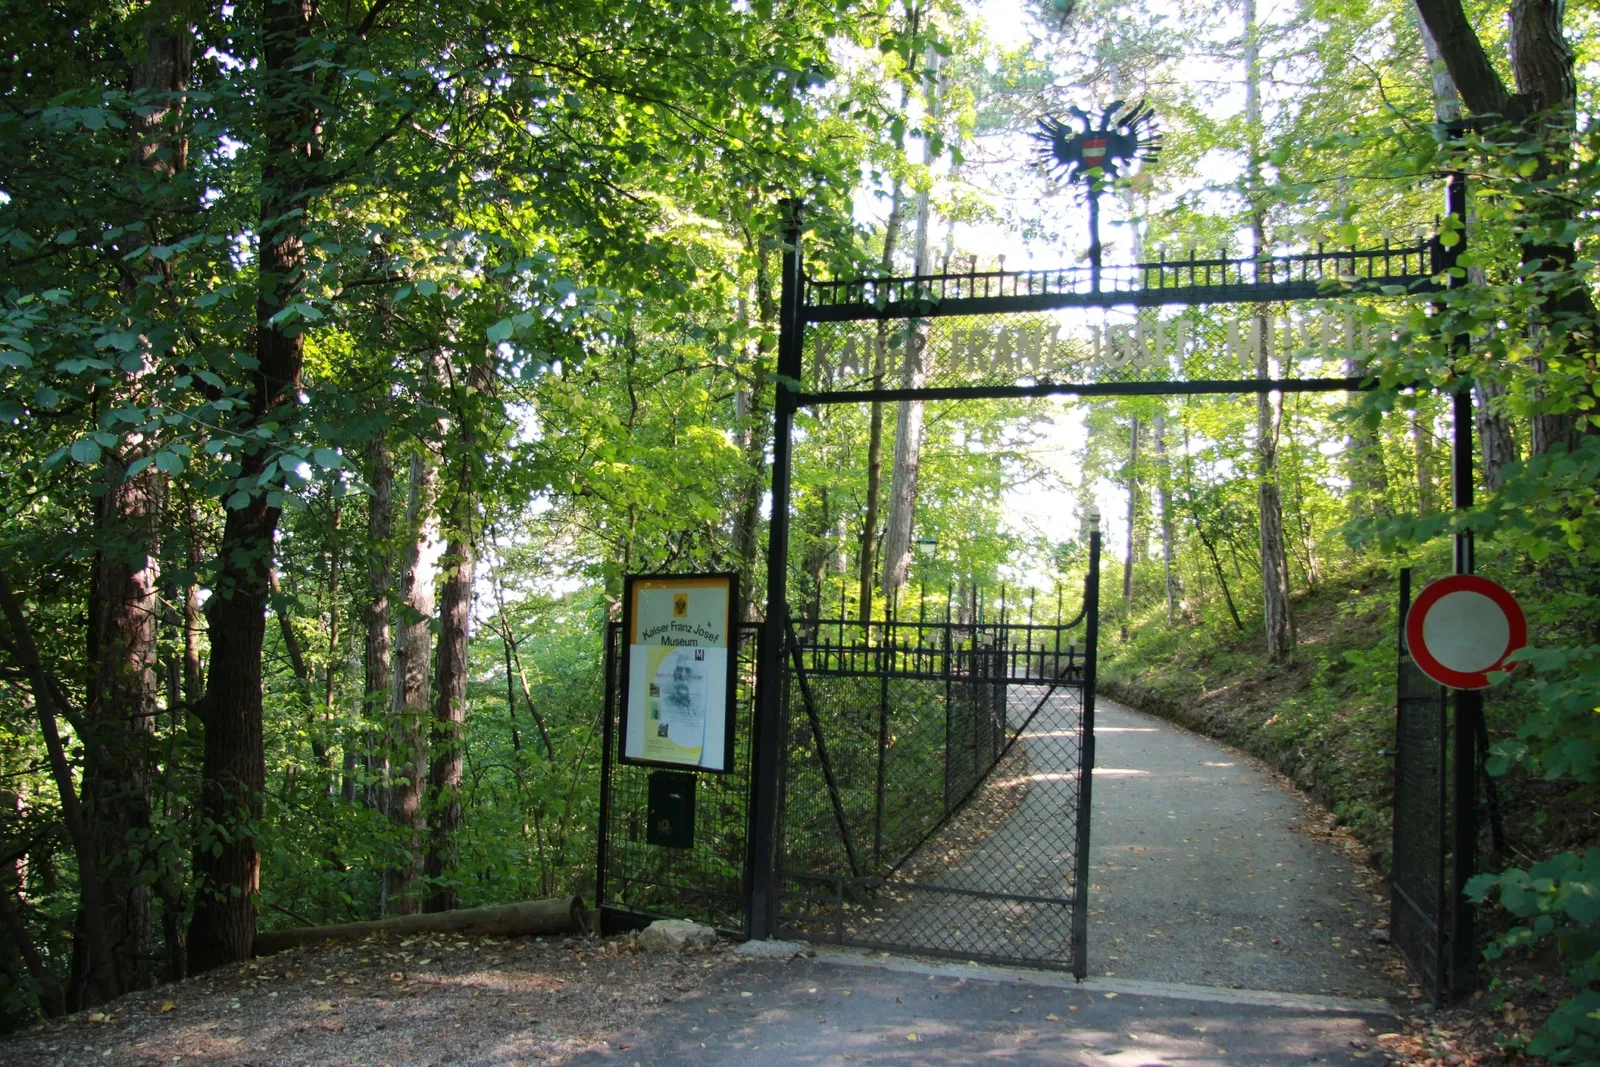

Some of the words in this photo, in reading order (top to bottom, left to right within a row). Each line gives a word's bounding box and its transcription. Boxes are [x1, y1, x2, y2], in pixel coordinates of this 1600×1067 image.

[814, 332, 927, 378] KAISER
[950, 325, 1062, 372] FRANZ
[1084, 320, 1194, 367] JOSEF
[642, 624, 669, 640] Kaiser
[670, 621, 692, 633] Franz
[693, 625, 719, 643] Josef
[661, 636, 698, 647] Museum
